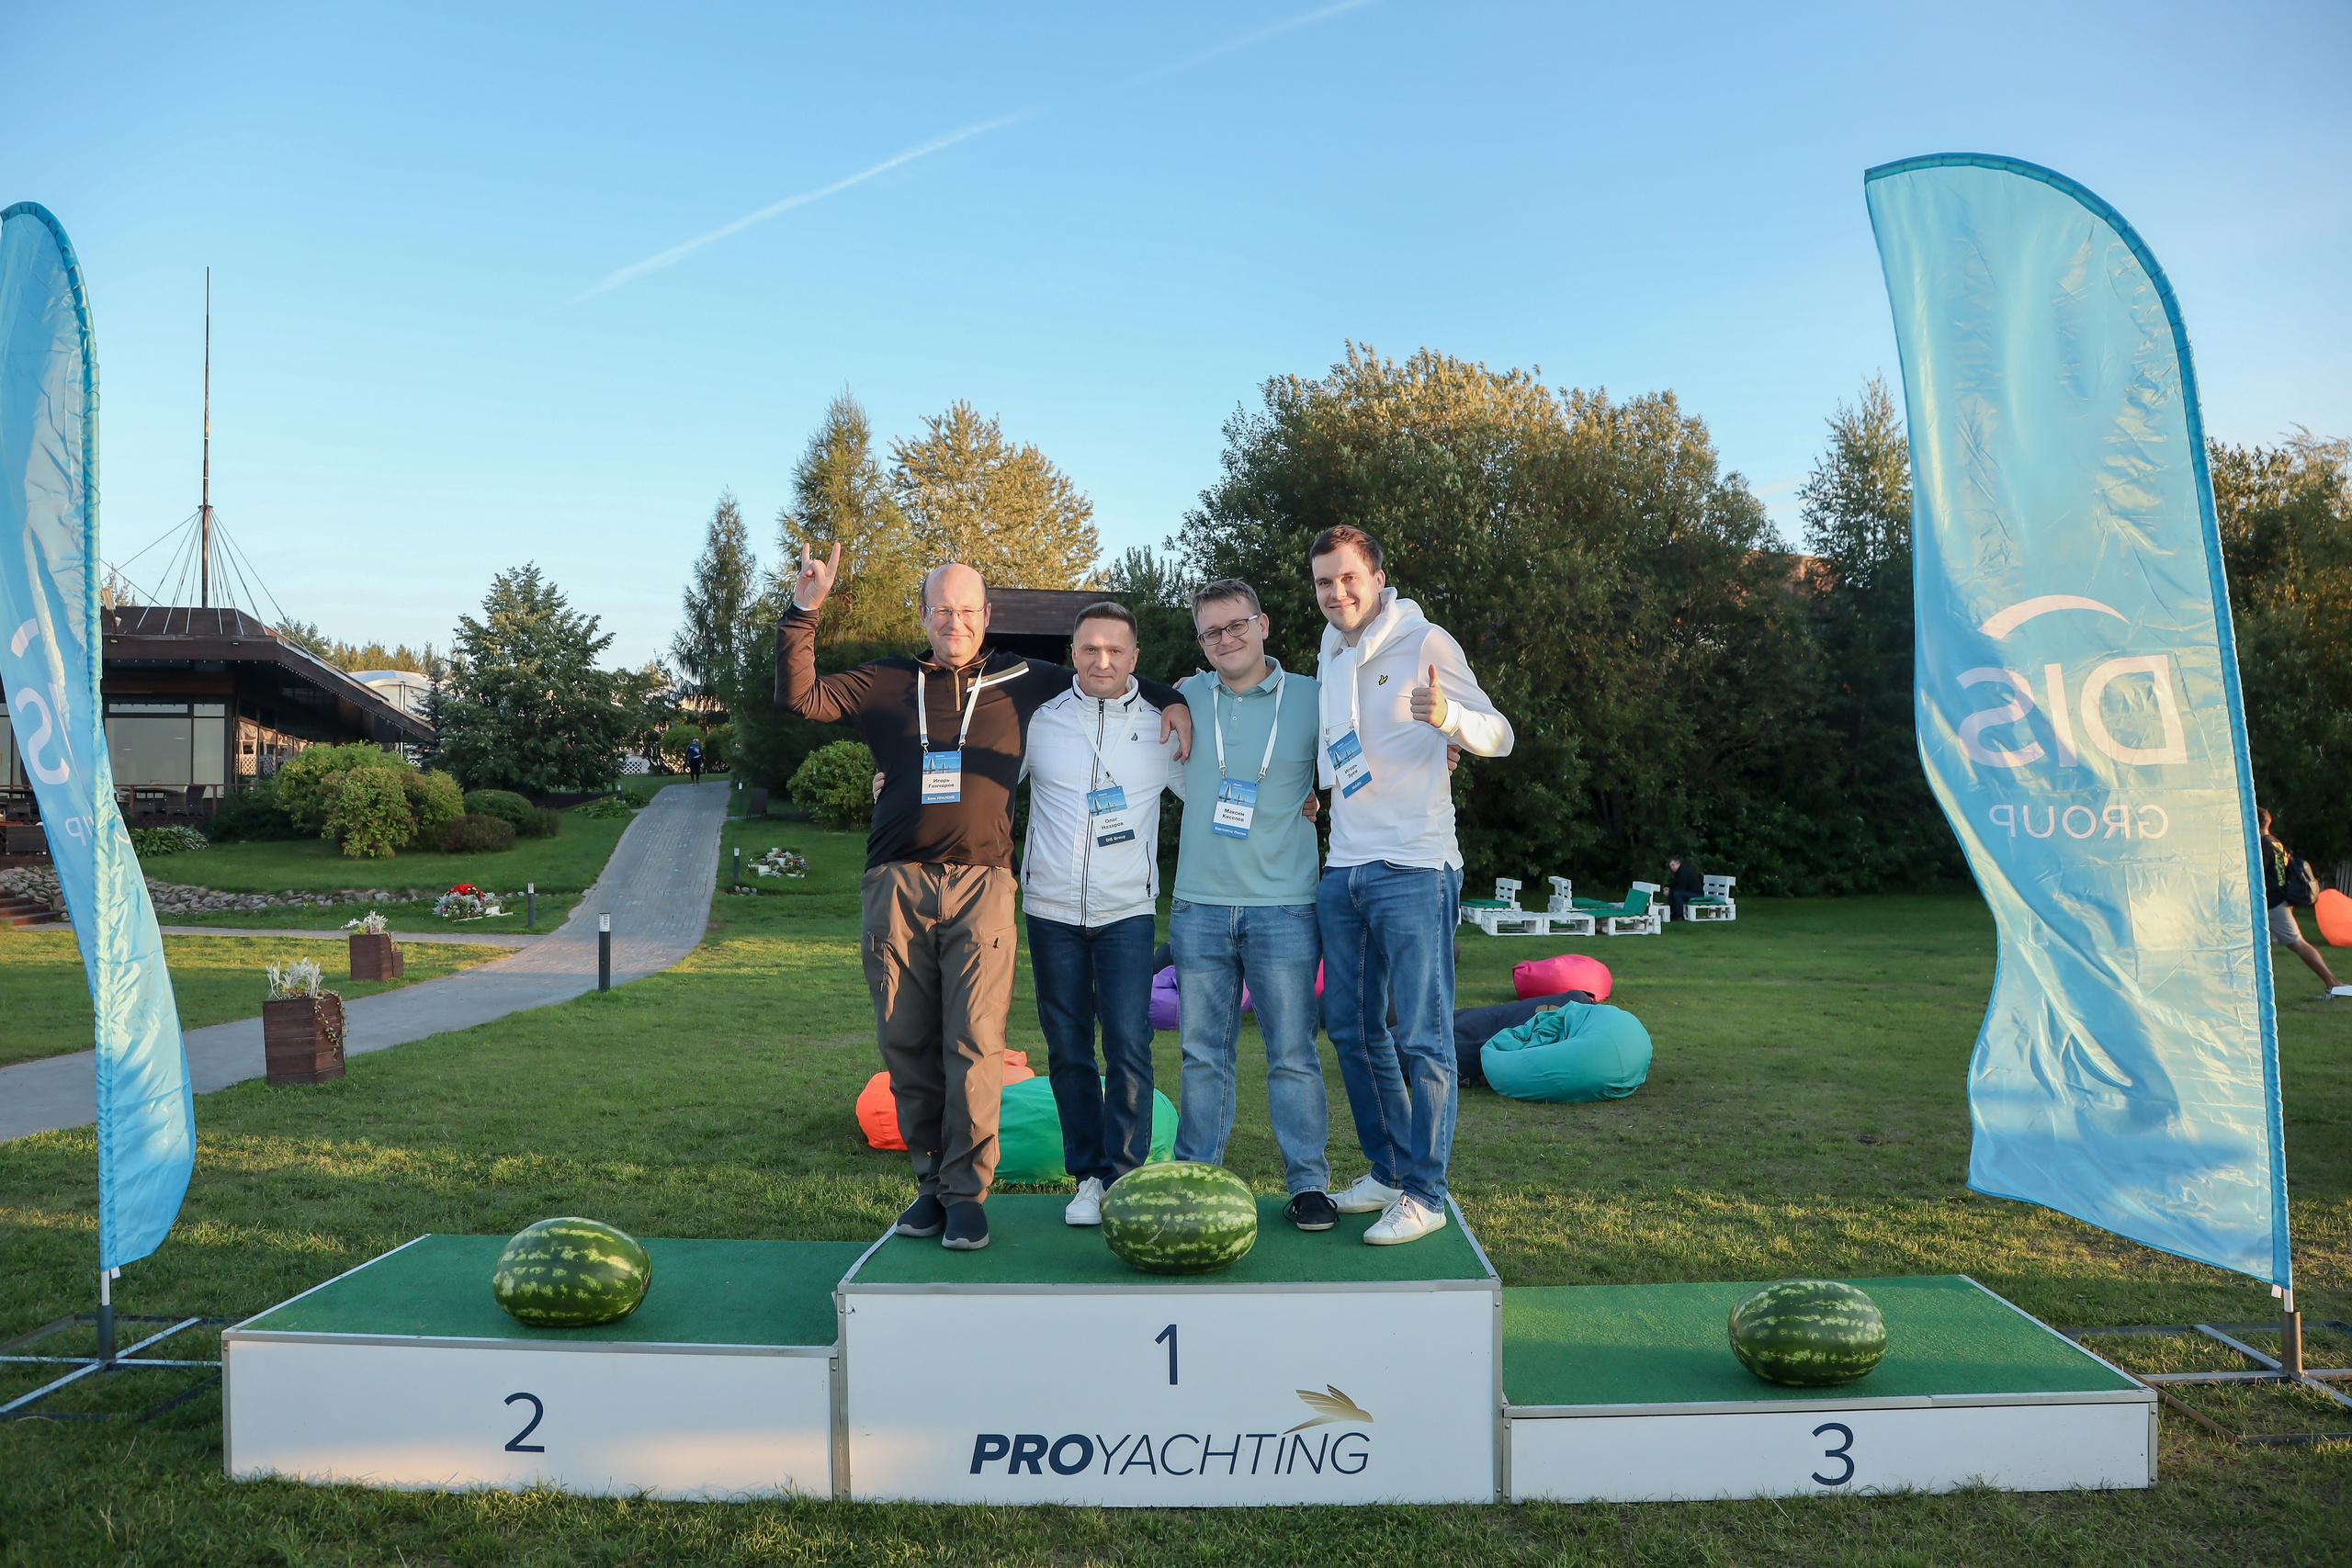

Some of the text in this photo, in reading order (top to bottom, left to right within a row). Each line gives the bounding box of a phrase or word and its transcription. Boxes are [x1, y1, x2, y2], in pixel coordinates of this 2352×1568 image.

[1102, 821, 1124, 829] Назаров
[1155, 1325, 1178, 1385] 1
[504, 1393, 545, 1452] 2
[1811, 1422, 1855, 1486] 3
